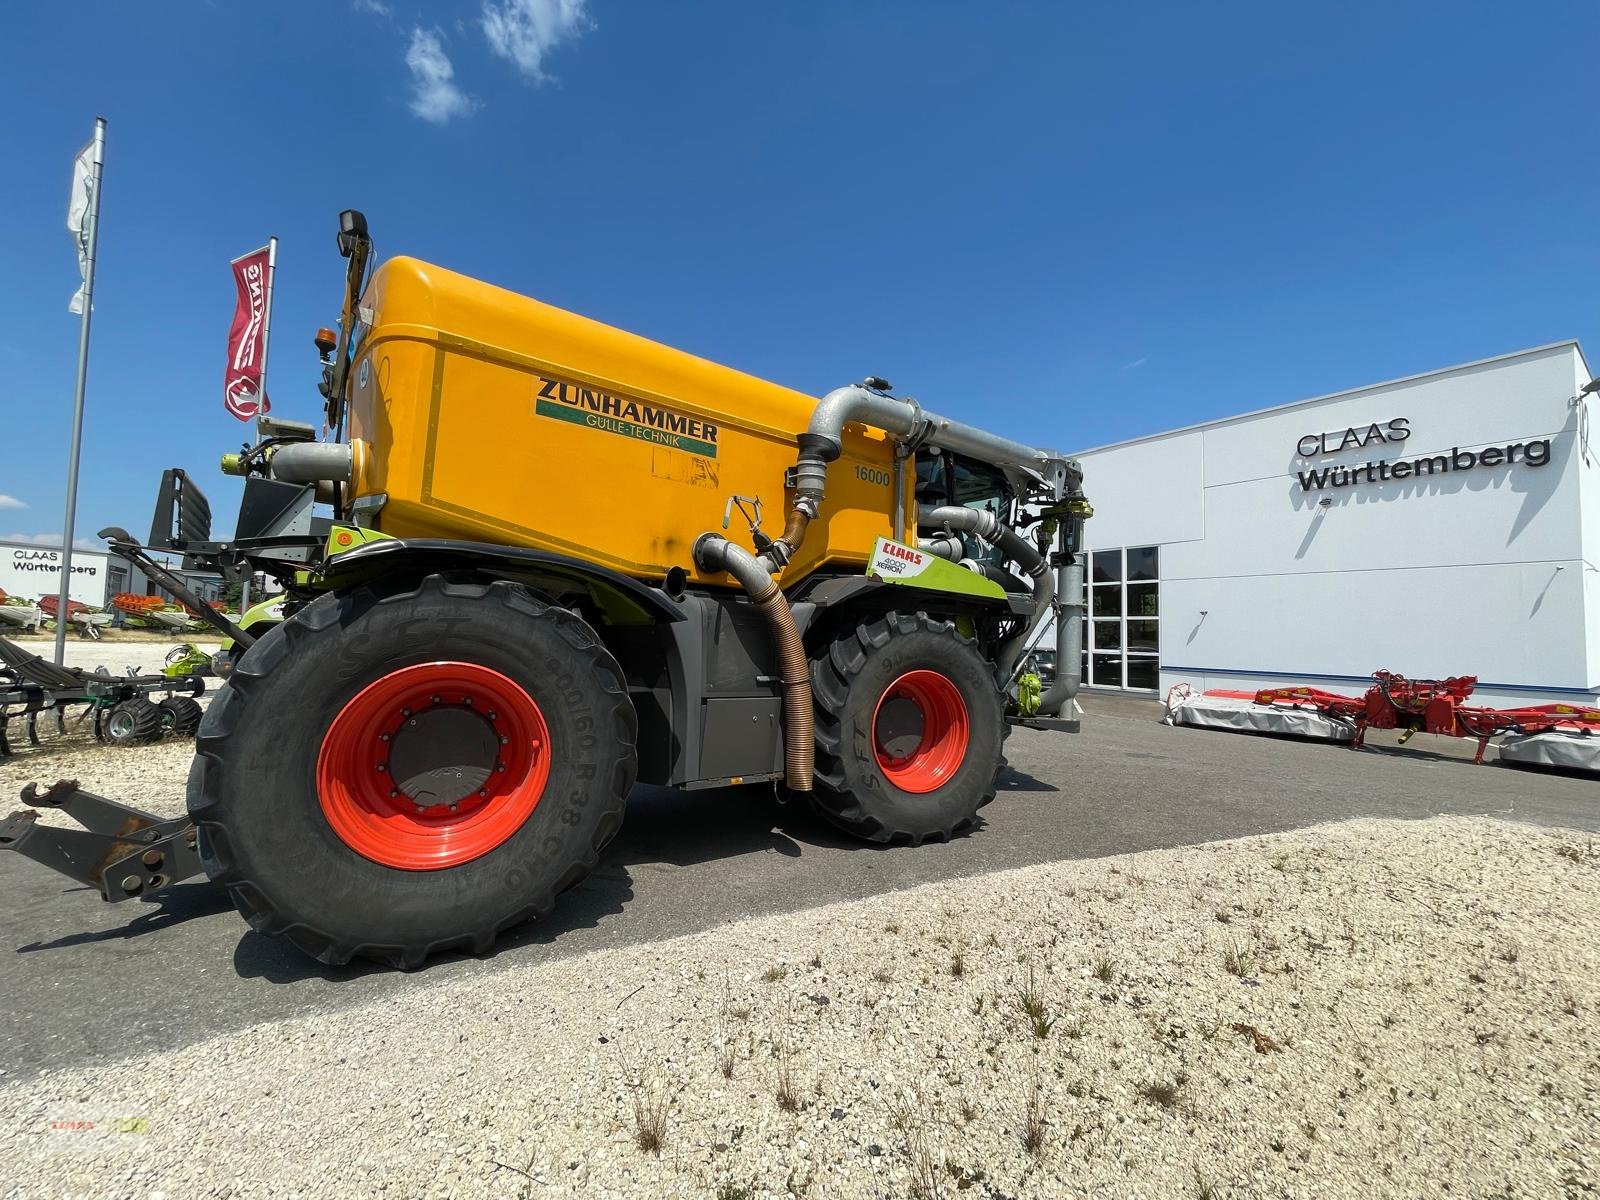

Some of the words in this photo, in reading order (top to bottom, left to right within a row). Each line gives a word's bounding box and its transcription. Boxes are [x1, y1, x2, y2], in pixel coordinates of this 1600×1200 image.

[538, 376, 718, 443] ZUNHAMMER
[586, 414, 681, 447] GÜLLE-TECHNIK
[1296, 417, 1411, 458] CLAAS
[854, 465, 891, 487] 16000
[1297, 438, 1552, 492] Württemberg
[13, 550, 58, 561] CLAAS
[882, 542, 923, 566] CLAAS
[884, 557, 907, 570] 4000
[876, 561, 903, 575] XERION
